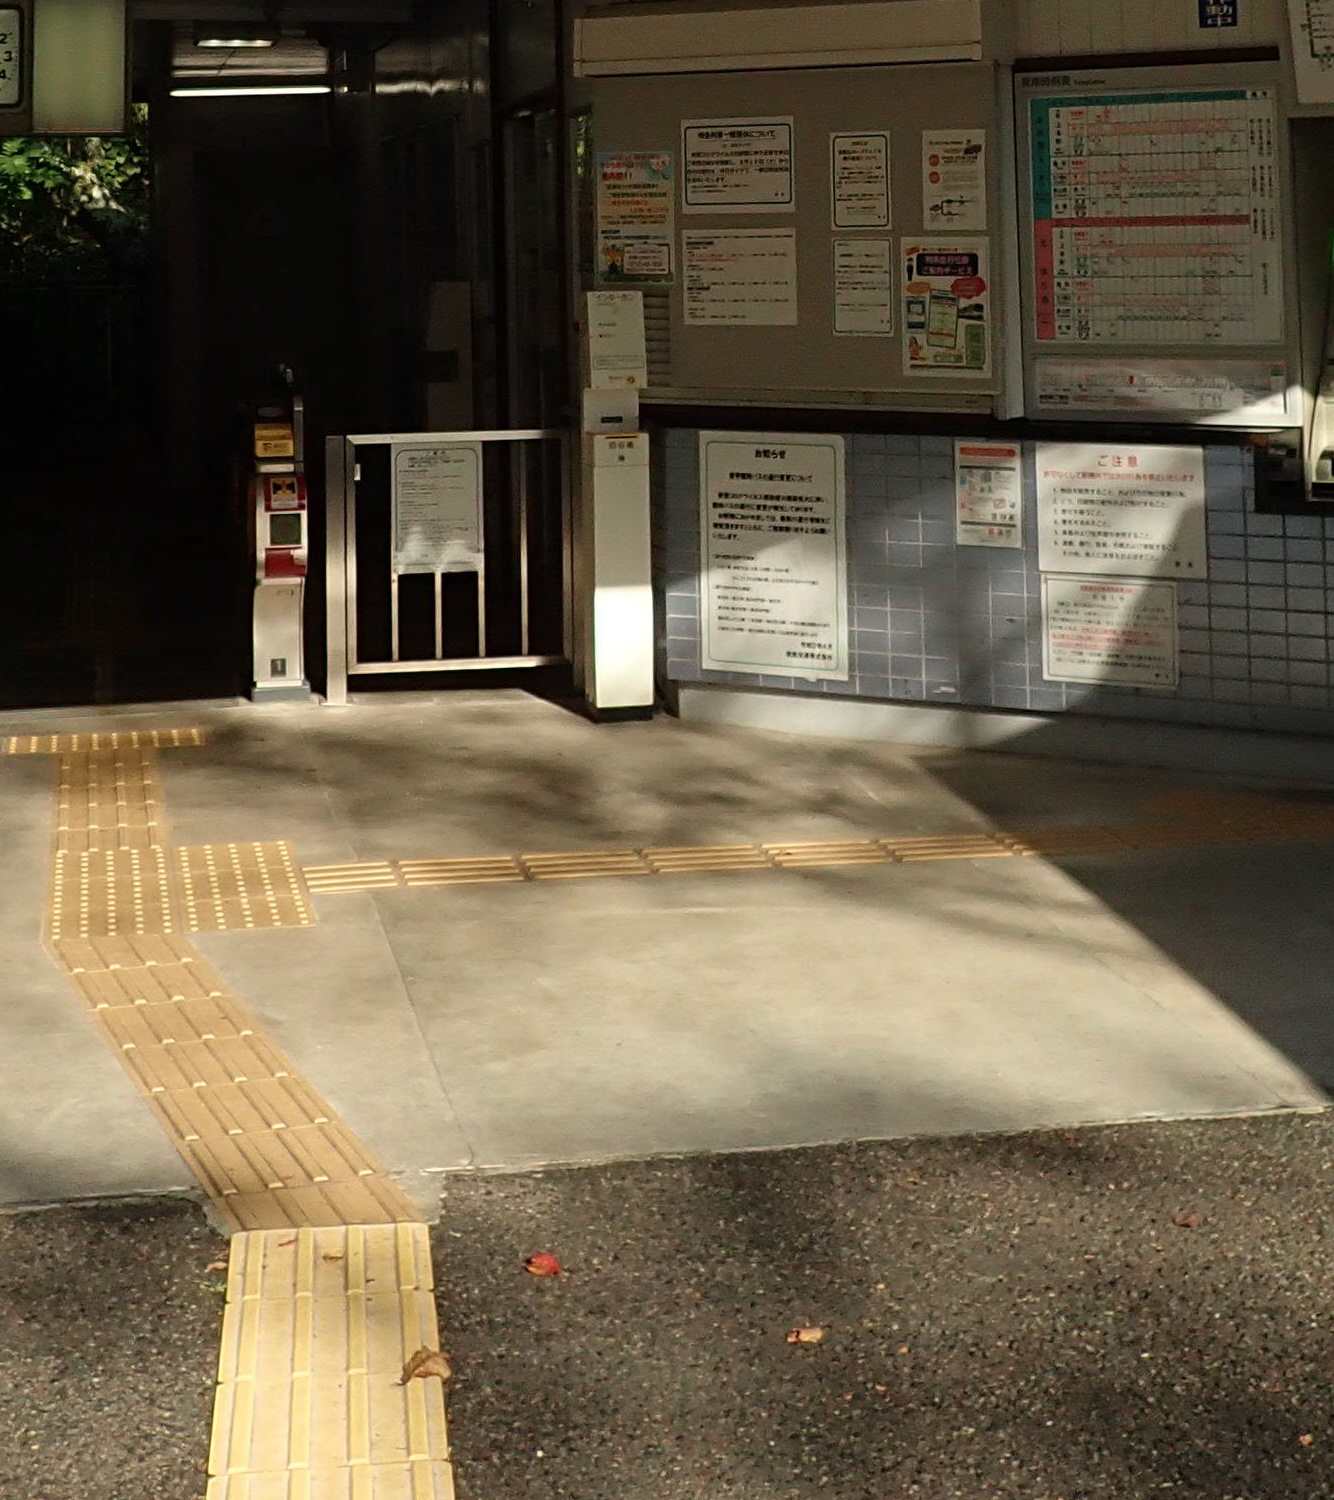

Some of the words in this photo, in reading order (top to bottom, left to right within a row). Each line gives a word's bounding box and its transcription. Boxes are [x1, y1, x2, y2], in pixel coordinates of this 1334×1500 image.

[3, 51, 12, 62] 3
[755, 449, 785, 459] お知らせ
[1098, 455, 1138, 468] ご注意
